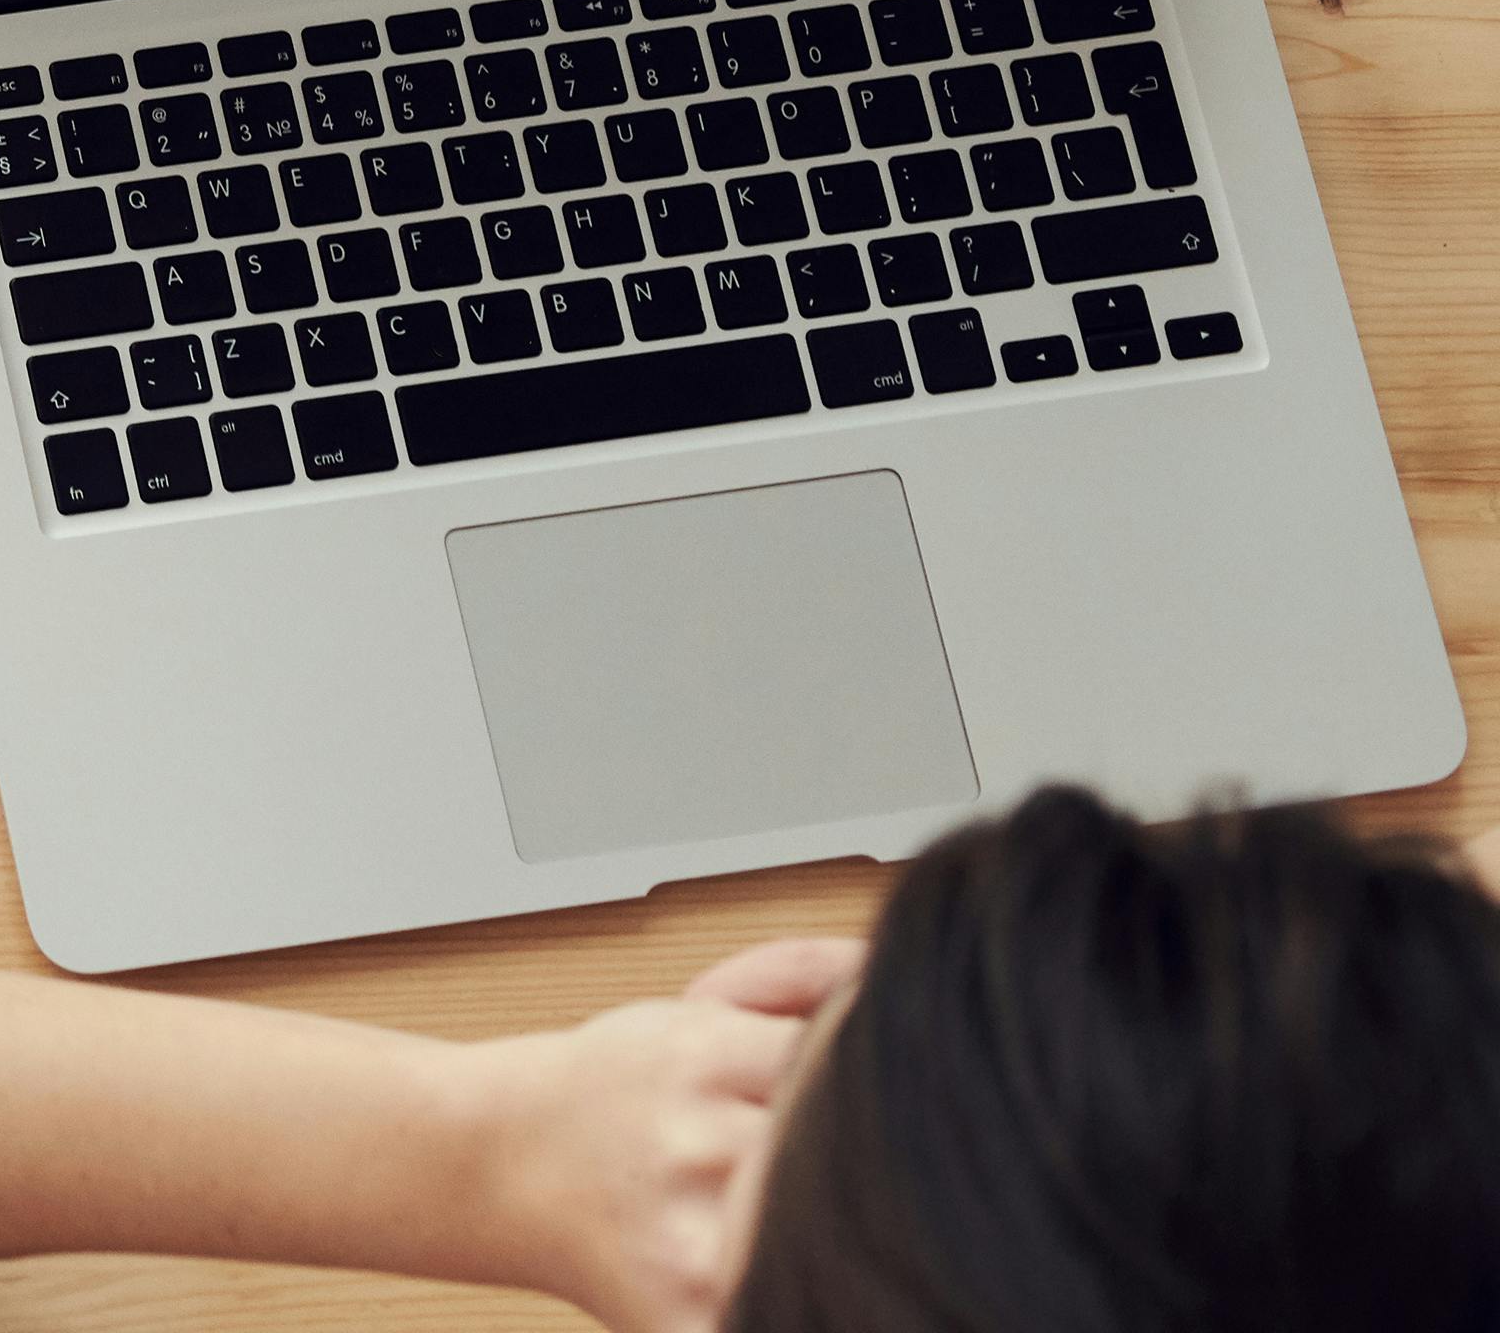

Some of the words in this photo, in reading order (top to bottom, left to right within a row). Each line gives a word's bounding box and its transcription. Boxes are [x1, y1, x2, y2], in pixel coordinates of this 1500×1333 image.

[128, 190, 148, 209] Q
[208, 178, 230, 199] W
[290, 168, 304, 187] E
[372, 157, 388, 177] R
[454, 145, 466, 165] T
[535, 134, 549, 154] Y
[616, 123, 634, 143] U
[780, 101, 798, 120] O
[860, 90, 874, 109] P
[157, 135, 171, 153] 2
[239, 124, 252, 142] 3
[322, 113, 334, 131] 4
[403, 102, 414, 121] 5
[484, 91, 496, 109] 6
[564, 79, 575, 98] 7
[646, 68, 659, 87] 8
[727, 57, 739, 76] 9
[808, 46, 822, 64] 0
[167, 266, 184, 286] A
[248, 254, 262, 274] S
[329, 243, 346, 263] D
[410, 231, 422, 251] F
[494, 220, 512, 240] G
[574, 208, 593, 229] H
[737, 186, 755, 206] K
[819, 176, 833, 196] L
[223, 338, 240, 359] Z
[307, 327, 325, 348] X
[390, 315, 406, 336] C
[470, 303, 485, 324] V
[552, 293, 568, 314] B
[634, 281, 653, 302] N
[718, 269, 740, 291] M
[69, 486, 84, 500] fn
[147, 474, 170, 490] ctrl
[221, 422, 236, 433] alt
[314, 449, 344, 466] cmd
[873, 370, 904, 388] cmd
[959, 319, 974, 331] alt
